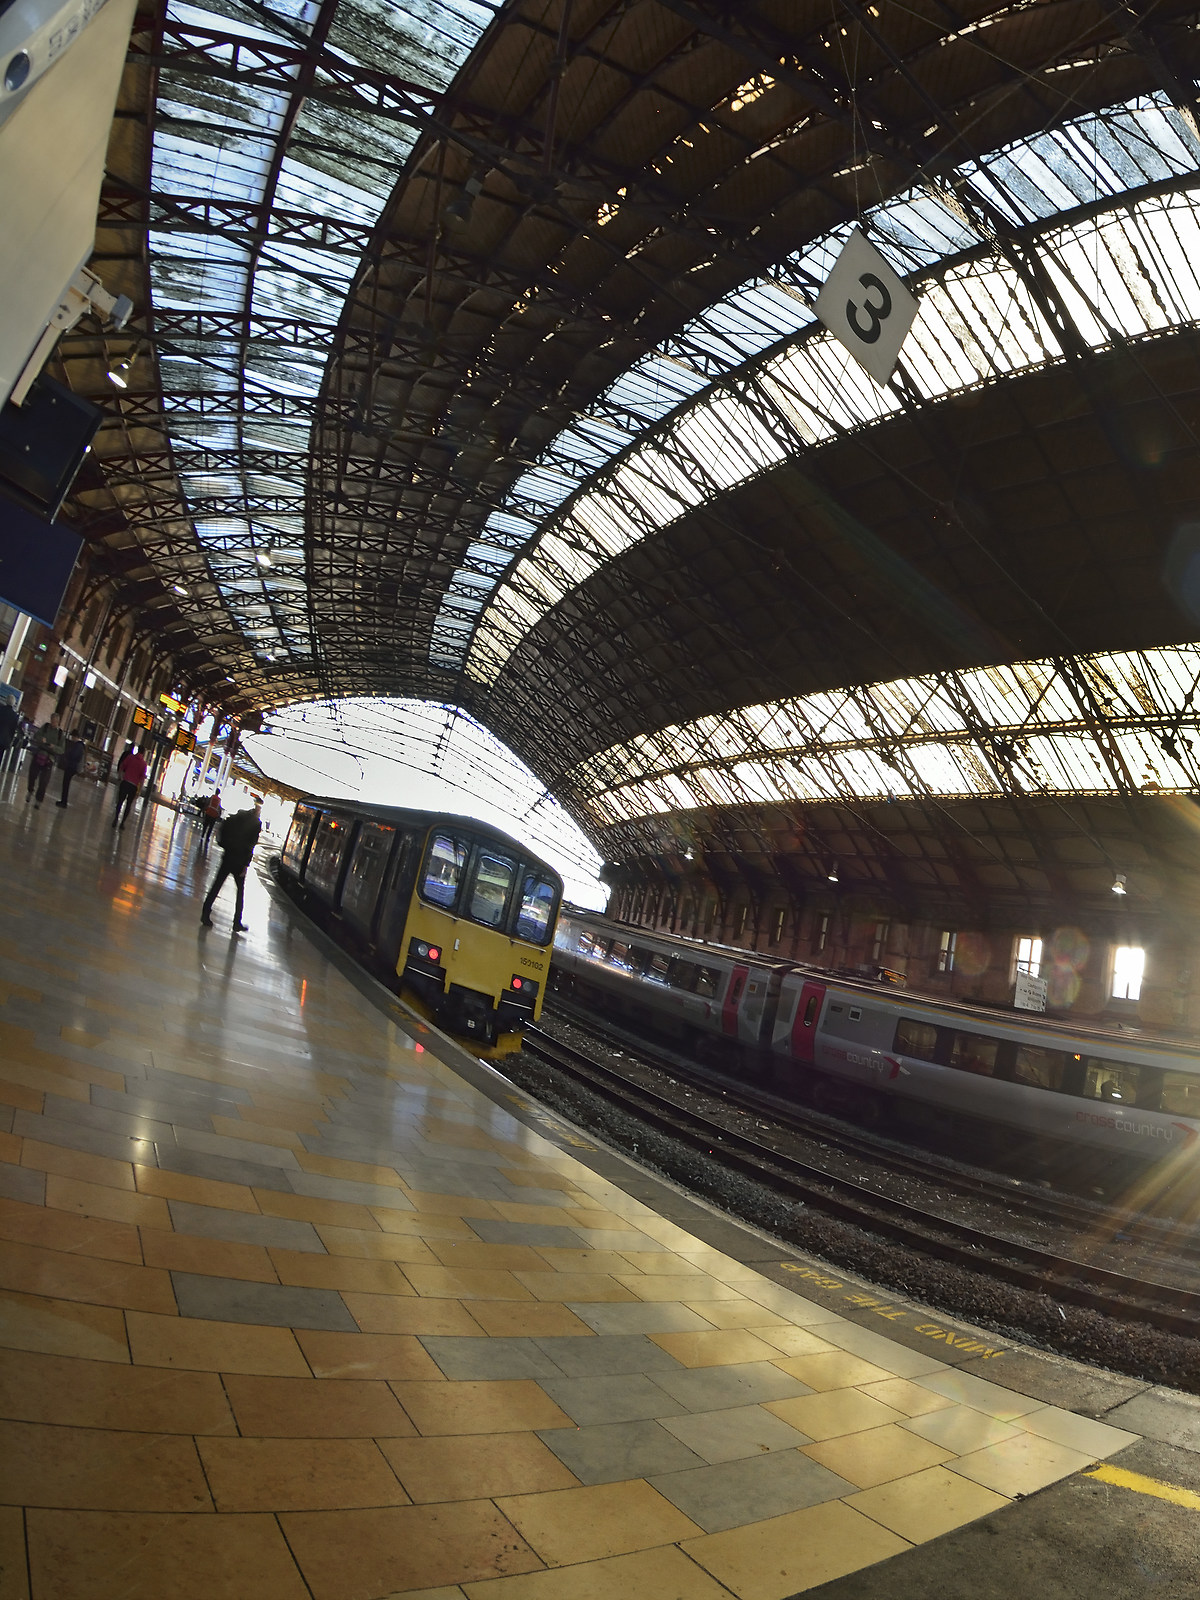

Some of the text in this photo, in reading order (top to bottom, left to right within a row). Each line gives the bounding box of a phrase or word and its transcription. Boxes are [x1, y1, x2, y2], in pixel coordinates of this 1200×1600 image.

[846, 272, 892, 345] 3
[822, 1045, 884, 1073] sscountry
[779, 1262, 1005, 1360] MIND THE GAP
